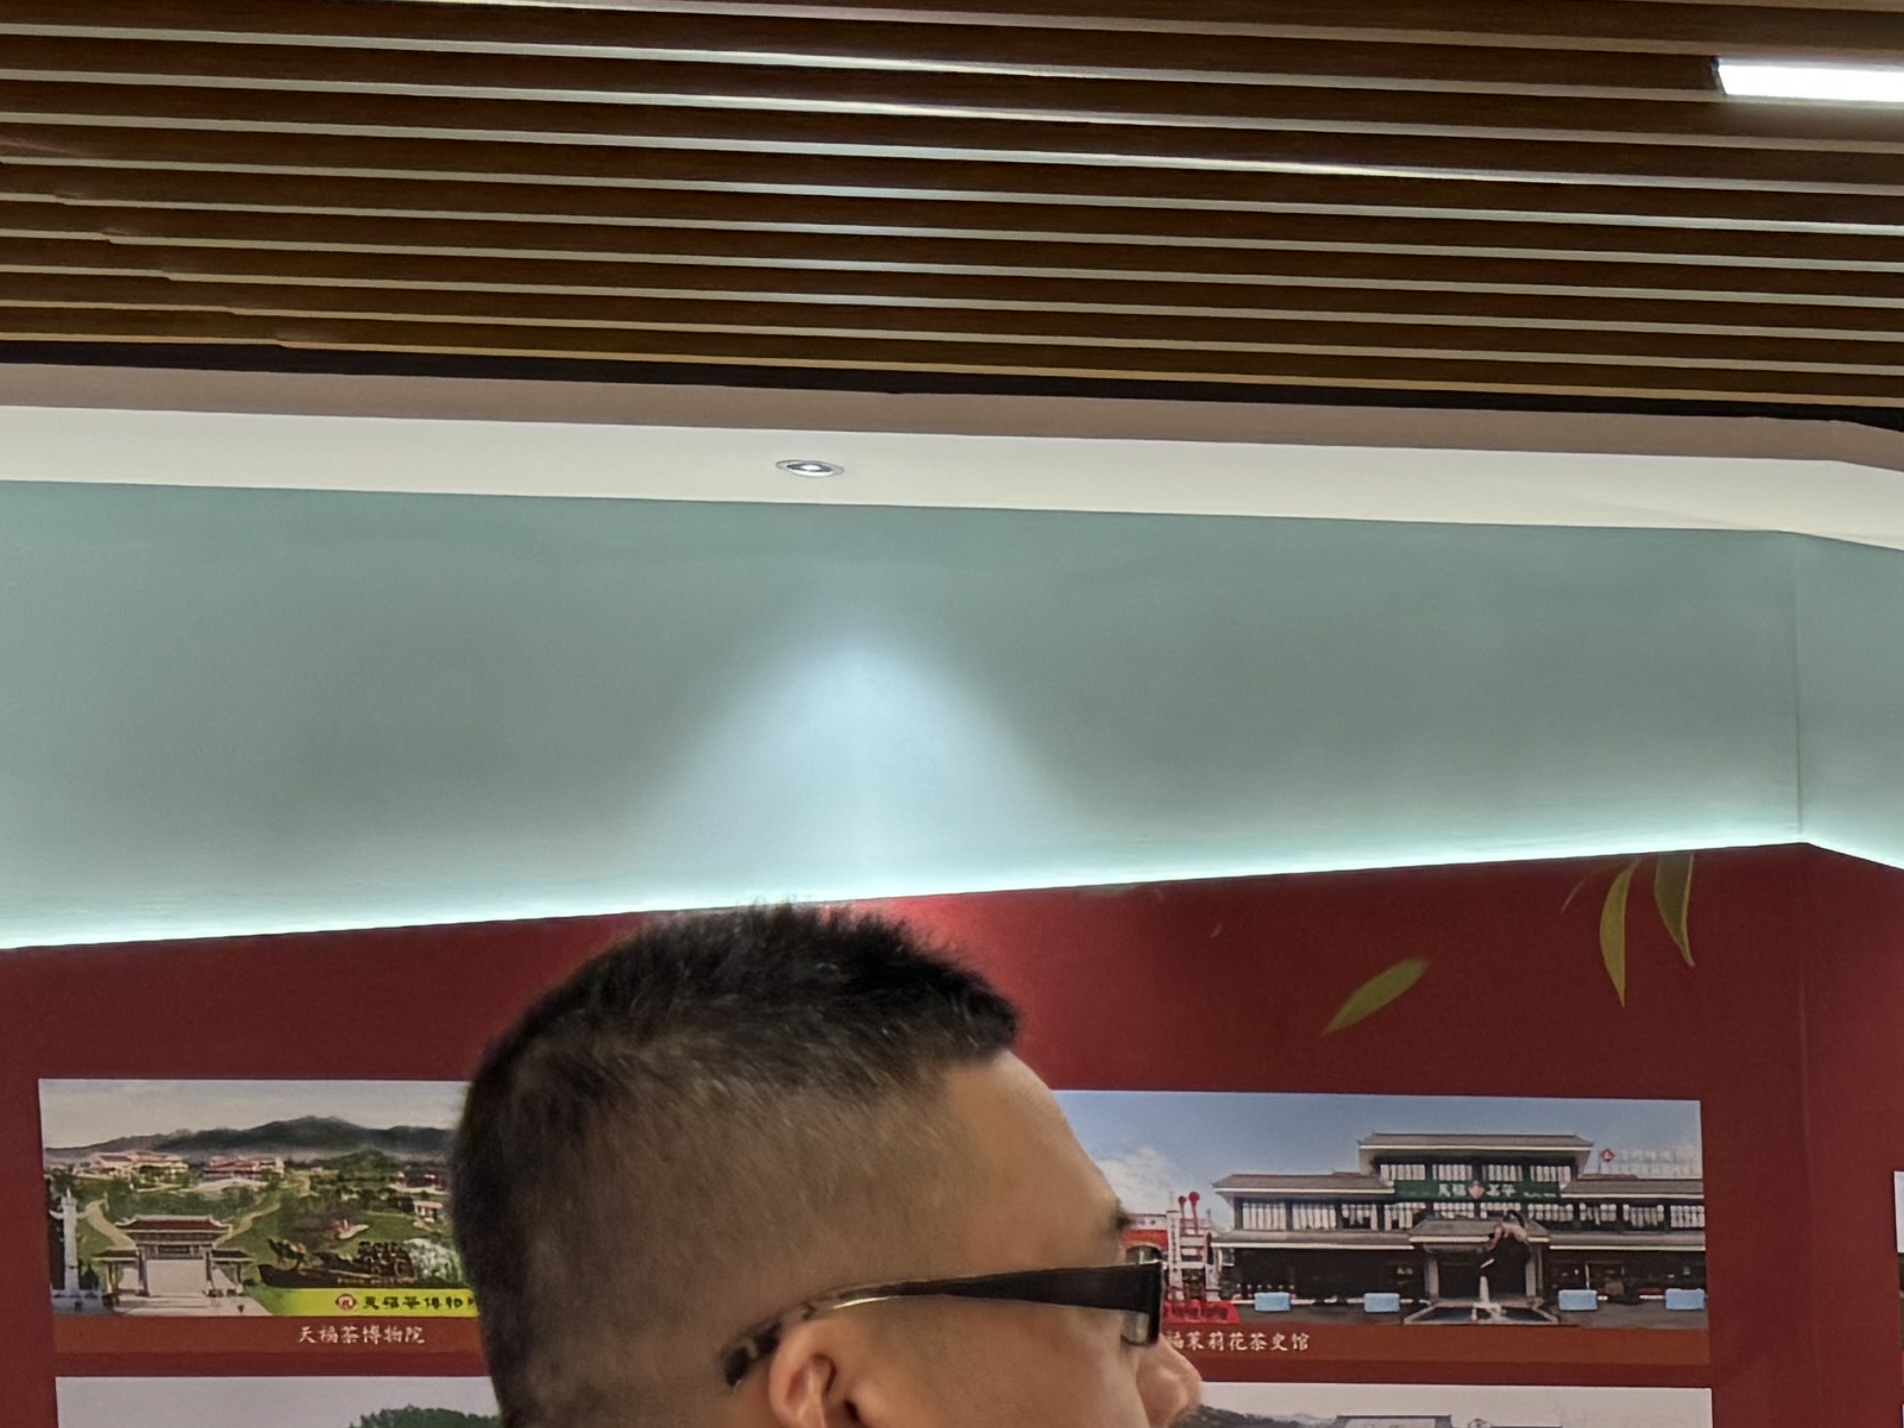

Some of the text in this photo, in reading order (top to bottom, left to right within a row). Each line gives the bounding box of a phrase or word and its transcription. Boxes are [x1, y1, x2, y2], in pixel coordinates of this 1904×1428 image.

[298, 1325, 426, 1344] 天福茶博物院
